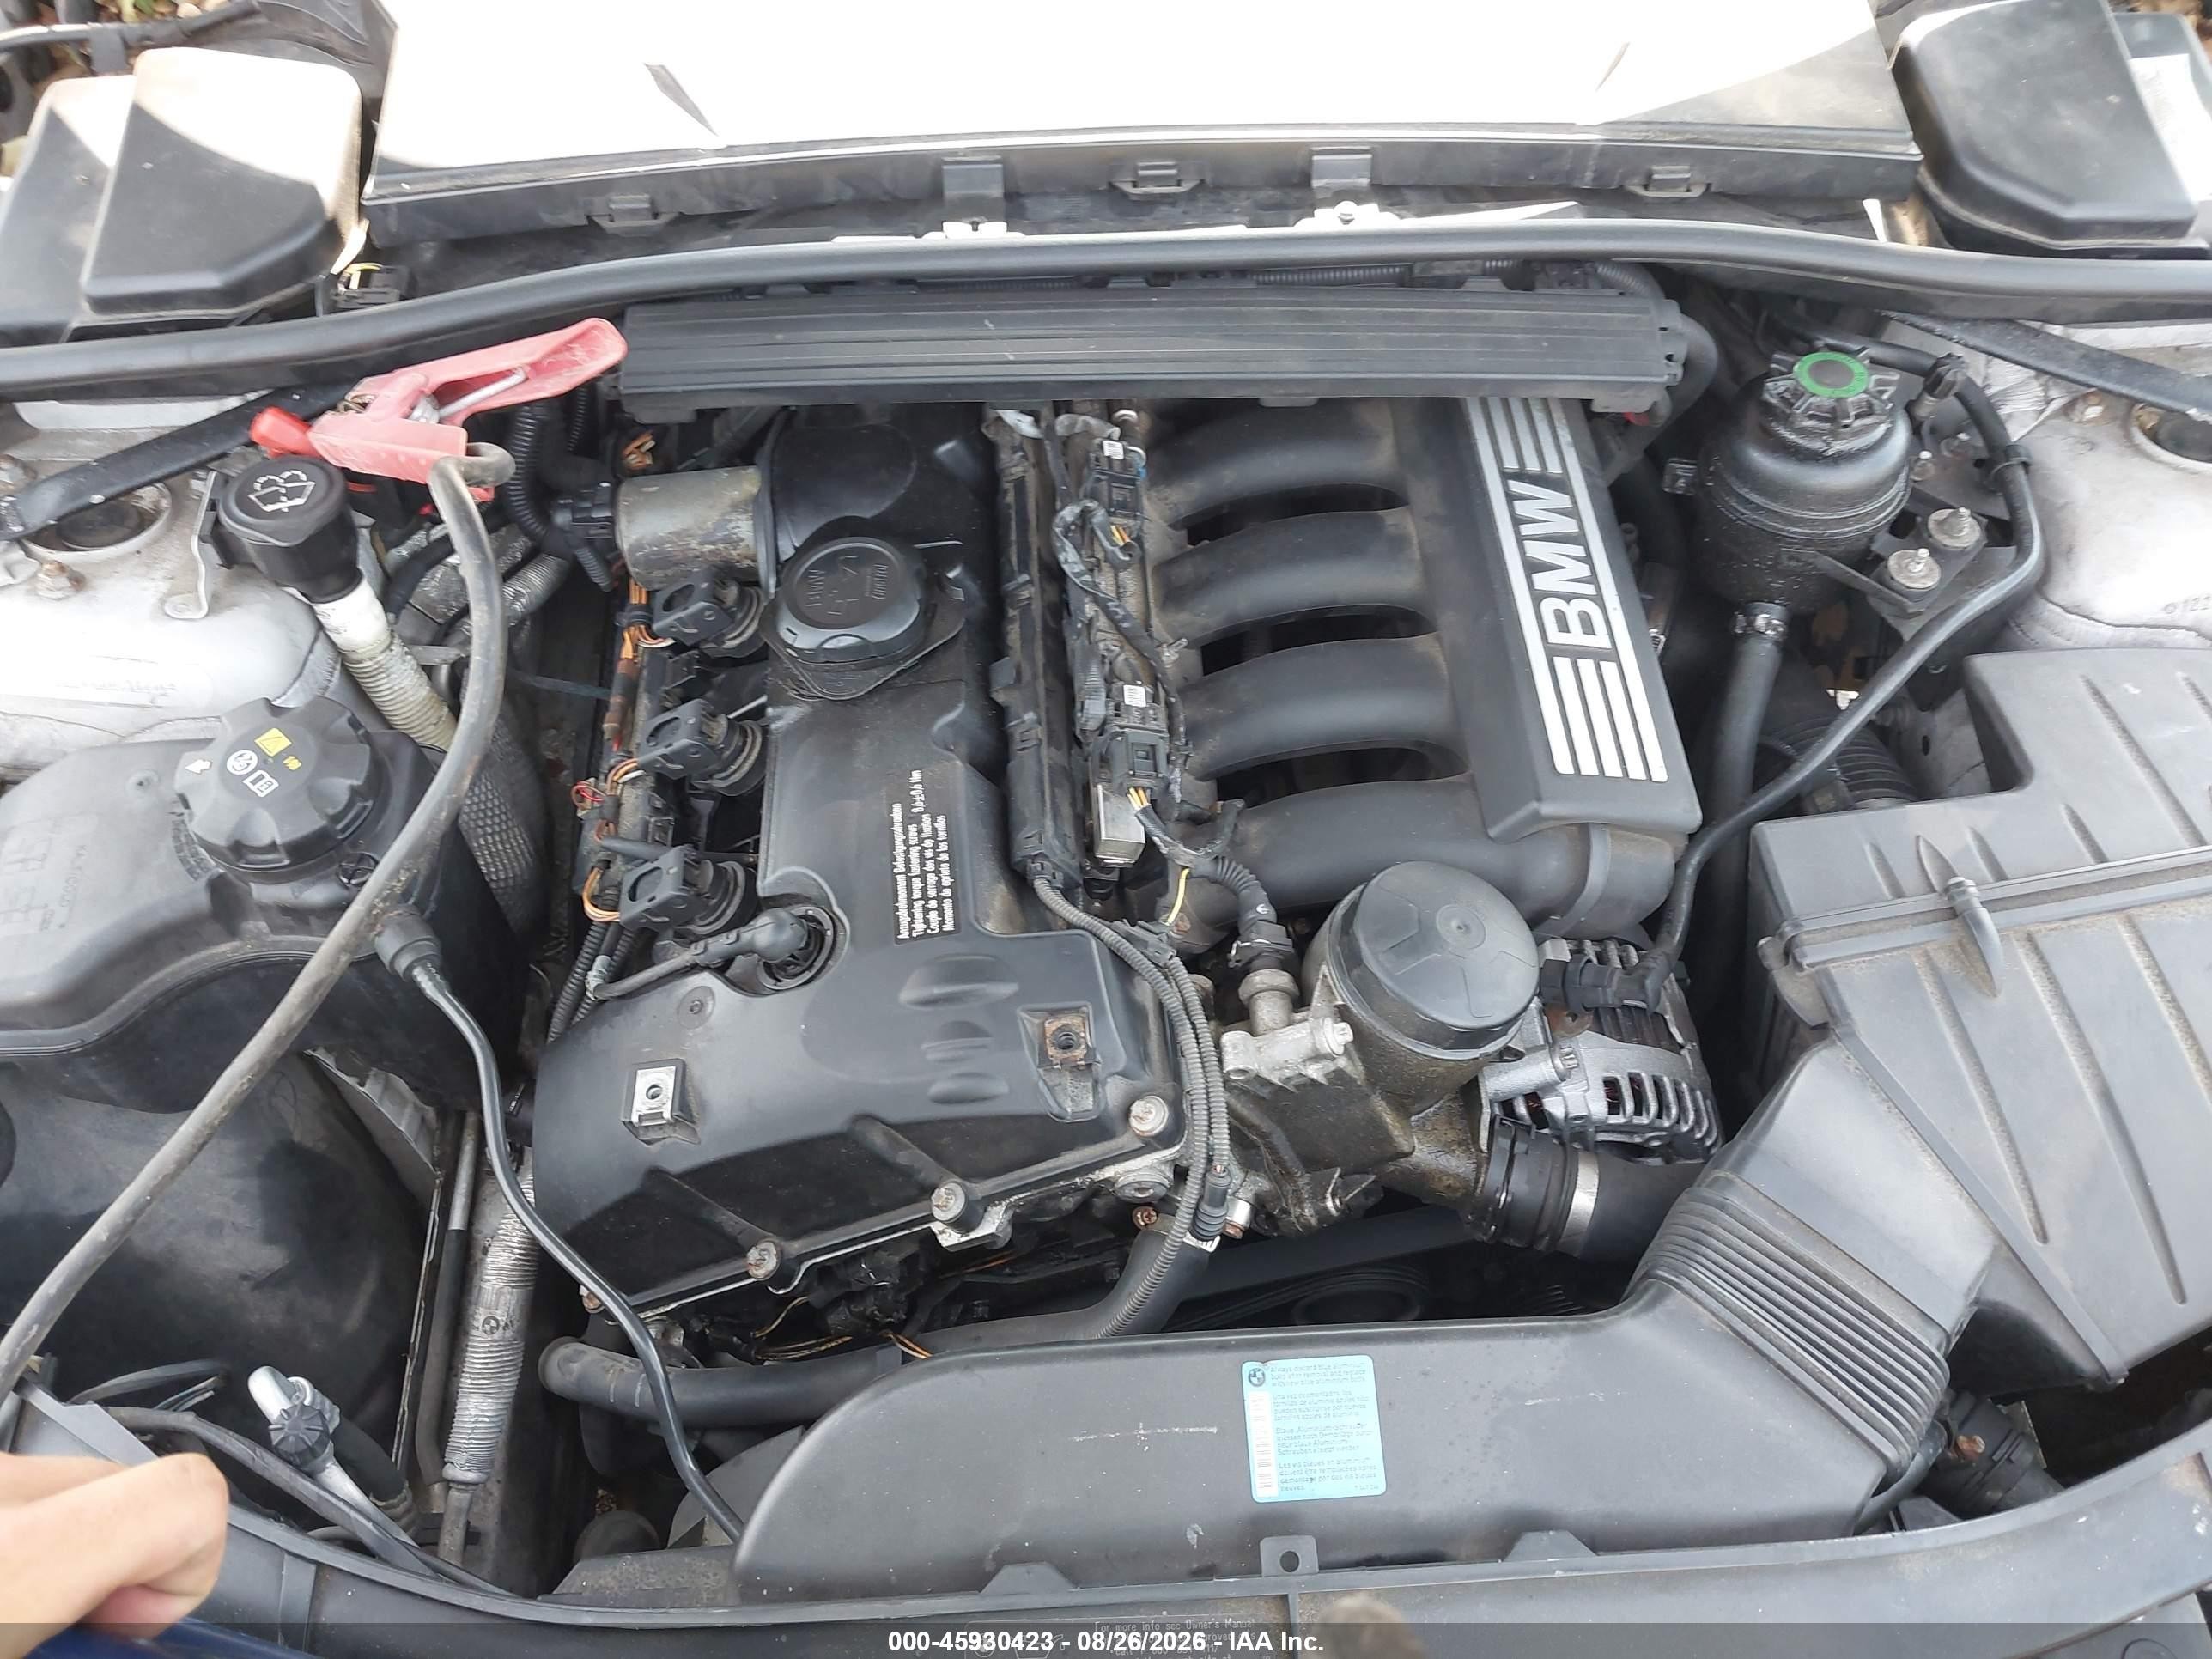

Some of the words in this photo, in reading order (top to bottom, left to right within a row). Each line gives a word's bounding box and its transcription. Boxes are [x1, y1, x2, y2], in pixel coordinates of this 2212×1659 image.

[1507, 479, 1612, 650] BMW
[908, 824, 919, 844] screws
[920, 813, 932, 837] fixation
[934, 816, 947, 840] tornillos
[922, 849, 933, 858] vis
[937, 842, 948, 851] los
[908, 846, 921, 876] fastening
[923, 860, 934, 871] des
[925, 873, 937, 897] serrage
[939, 863, 954, 885] apriete
[910, 878, 925, 898] torque
[925, 900, 937, 908] de
[942, 898, 955, 931] Momento
[912, 901, 927, 936] Tightening
[927, 910, 941, 933] Couple
[1095, 1621, 1110, 1632] For
[1142, 1620, 1160, 1631] info
[1166, 1622, 1181, 1631] see
[1186, 1618, 1220, 1630] Owner's
[1224, 1617, 1255, 1629] Manual
